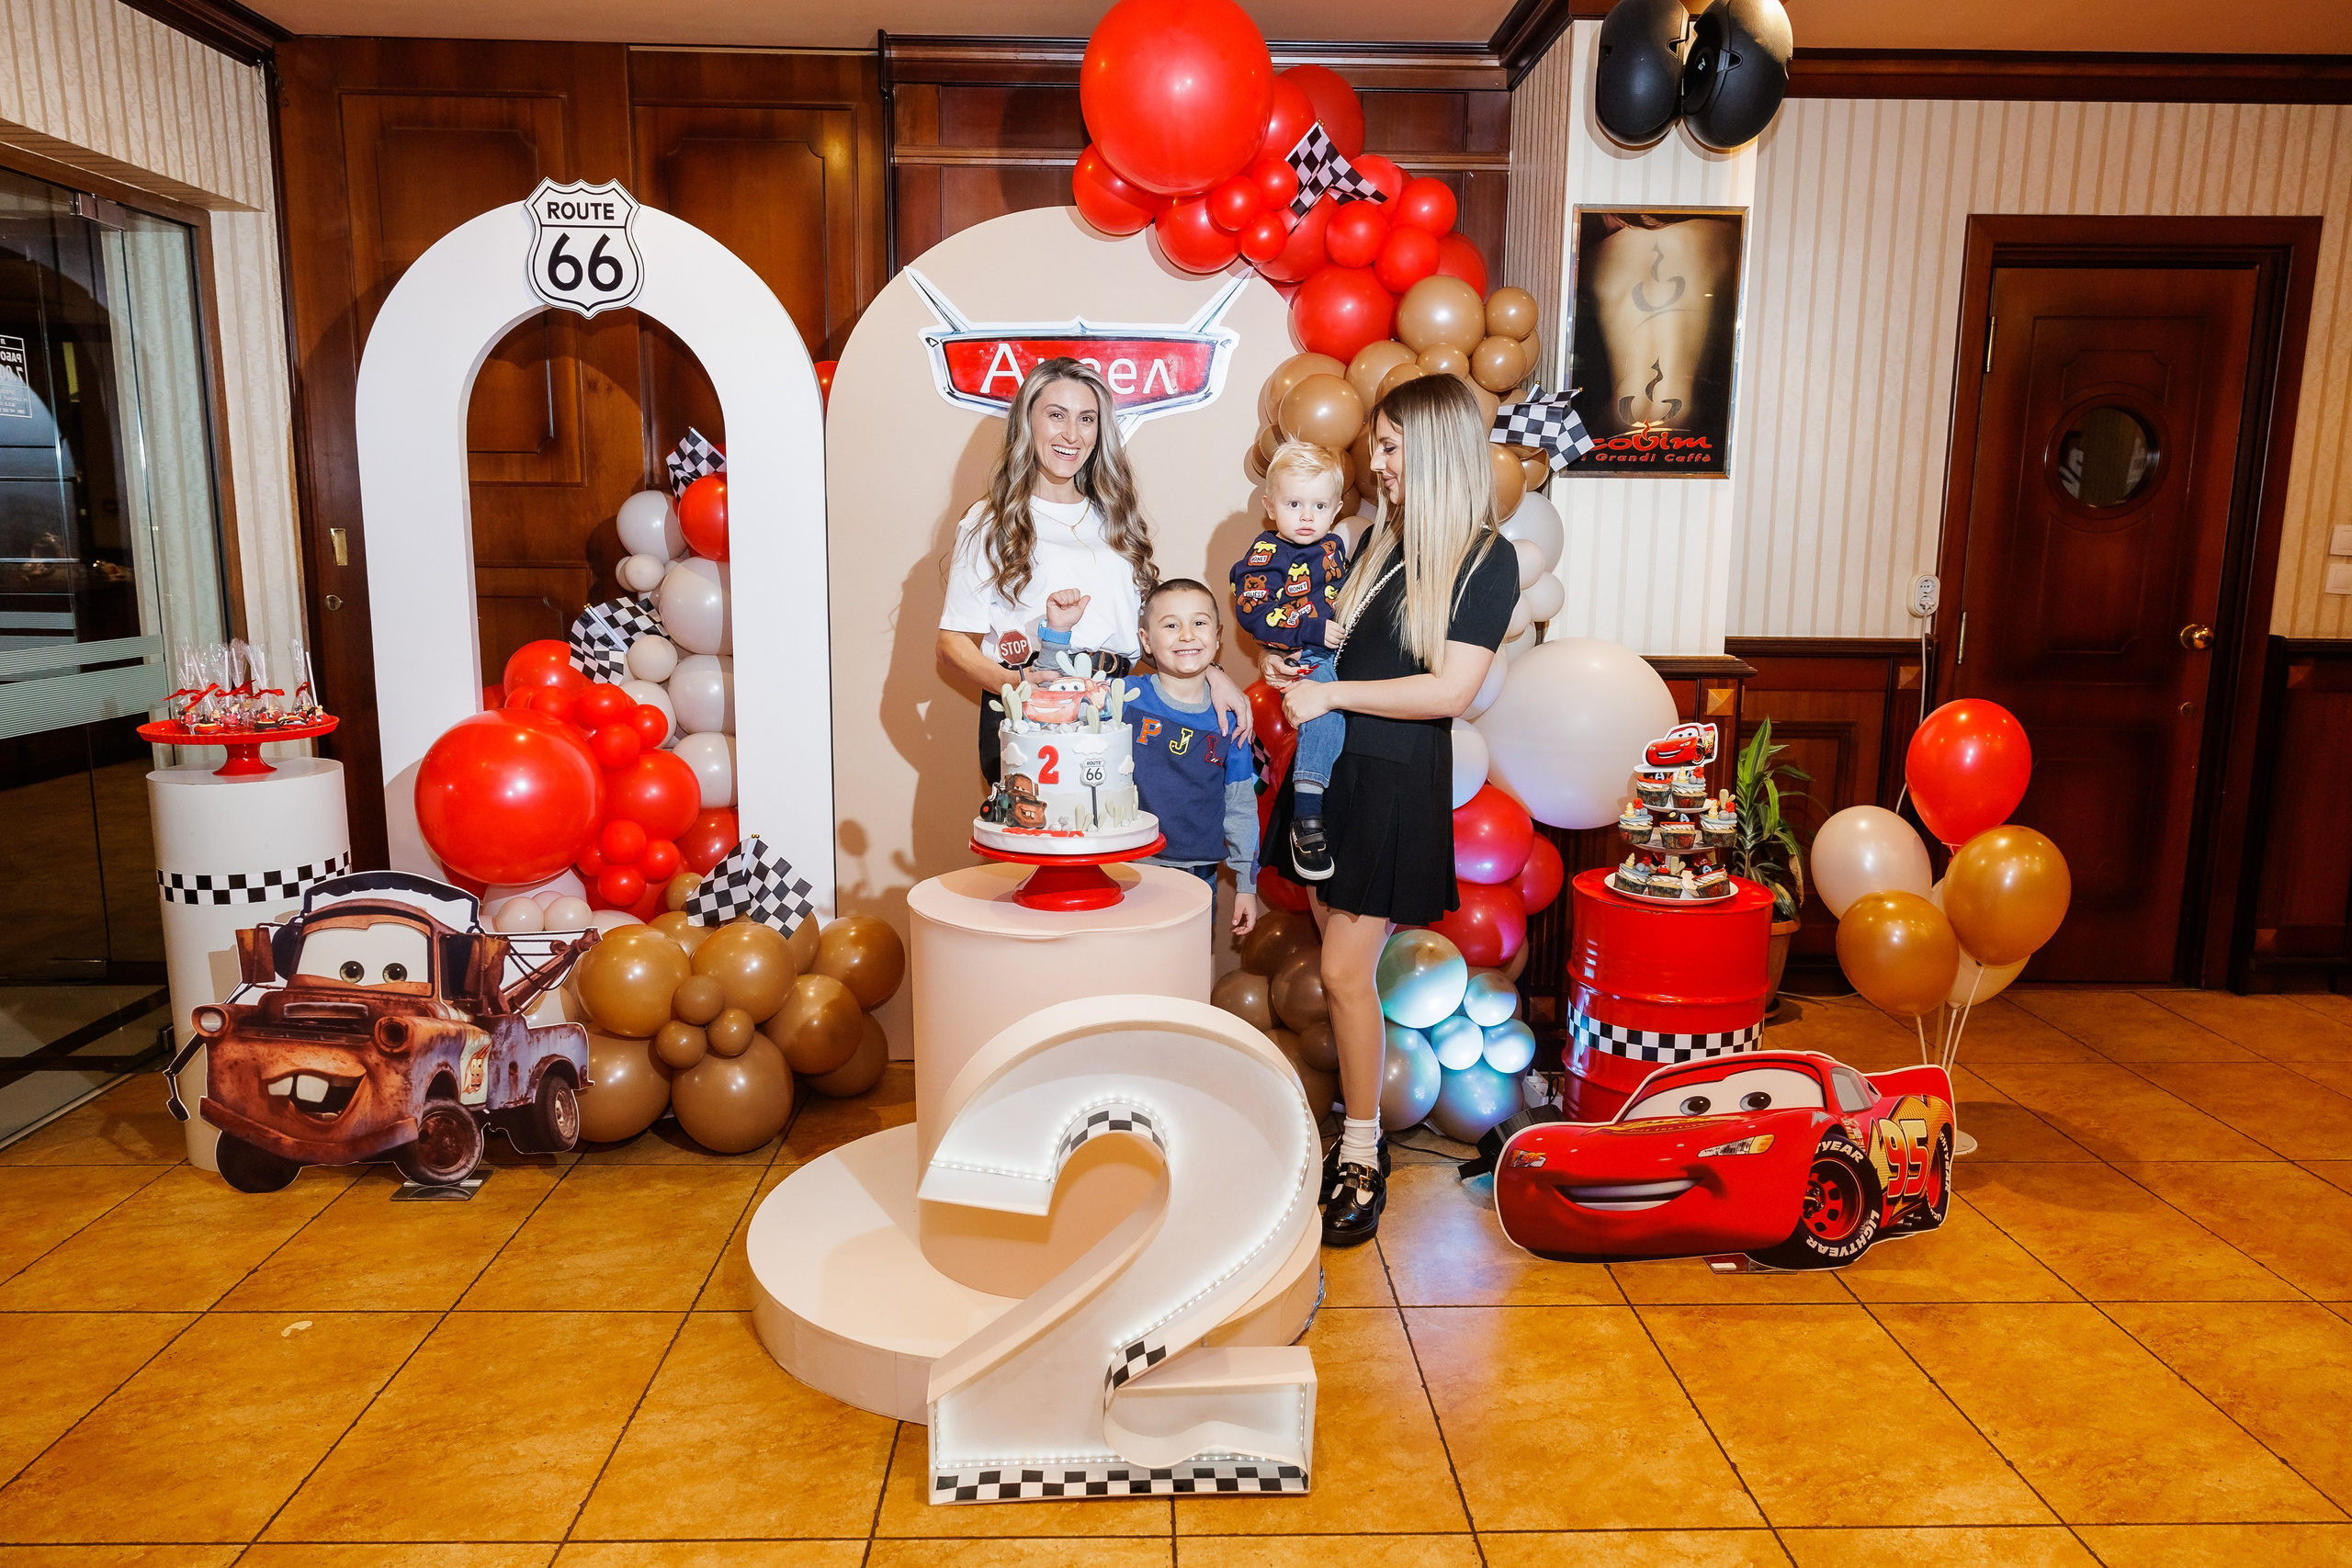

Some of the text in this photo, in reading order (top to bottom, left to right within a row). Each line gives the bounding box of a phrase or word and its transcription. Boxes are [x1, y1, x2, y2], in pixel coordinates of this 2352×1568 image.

[547, 201, 615, 220] ROUTE
[548, 231, 624, 292] 66
[1595, 452, 1657, 463] Grandi
[1664, 453, 1712, 463] Caffè
[1289, 582, 1307, 593] HONEY
[1000, 639, 1027, 657] STOP
[1136, 716, 1162, 745] P
[1169, 727, 1193, 755] J
[1038, 745, 1059, 784] 2
[1086, 767, 1102, 781] 66
[1679, 813, 1690, 823] A
[1879, 1118, 1928, 1199] 95
[1805, 1209, 1881, 1258] LIGHTYEAR
[917, 994, 1323, 1506] 2
